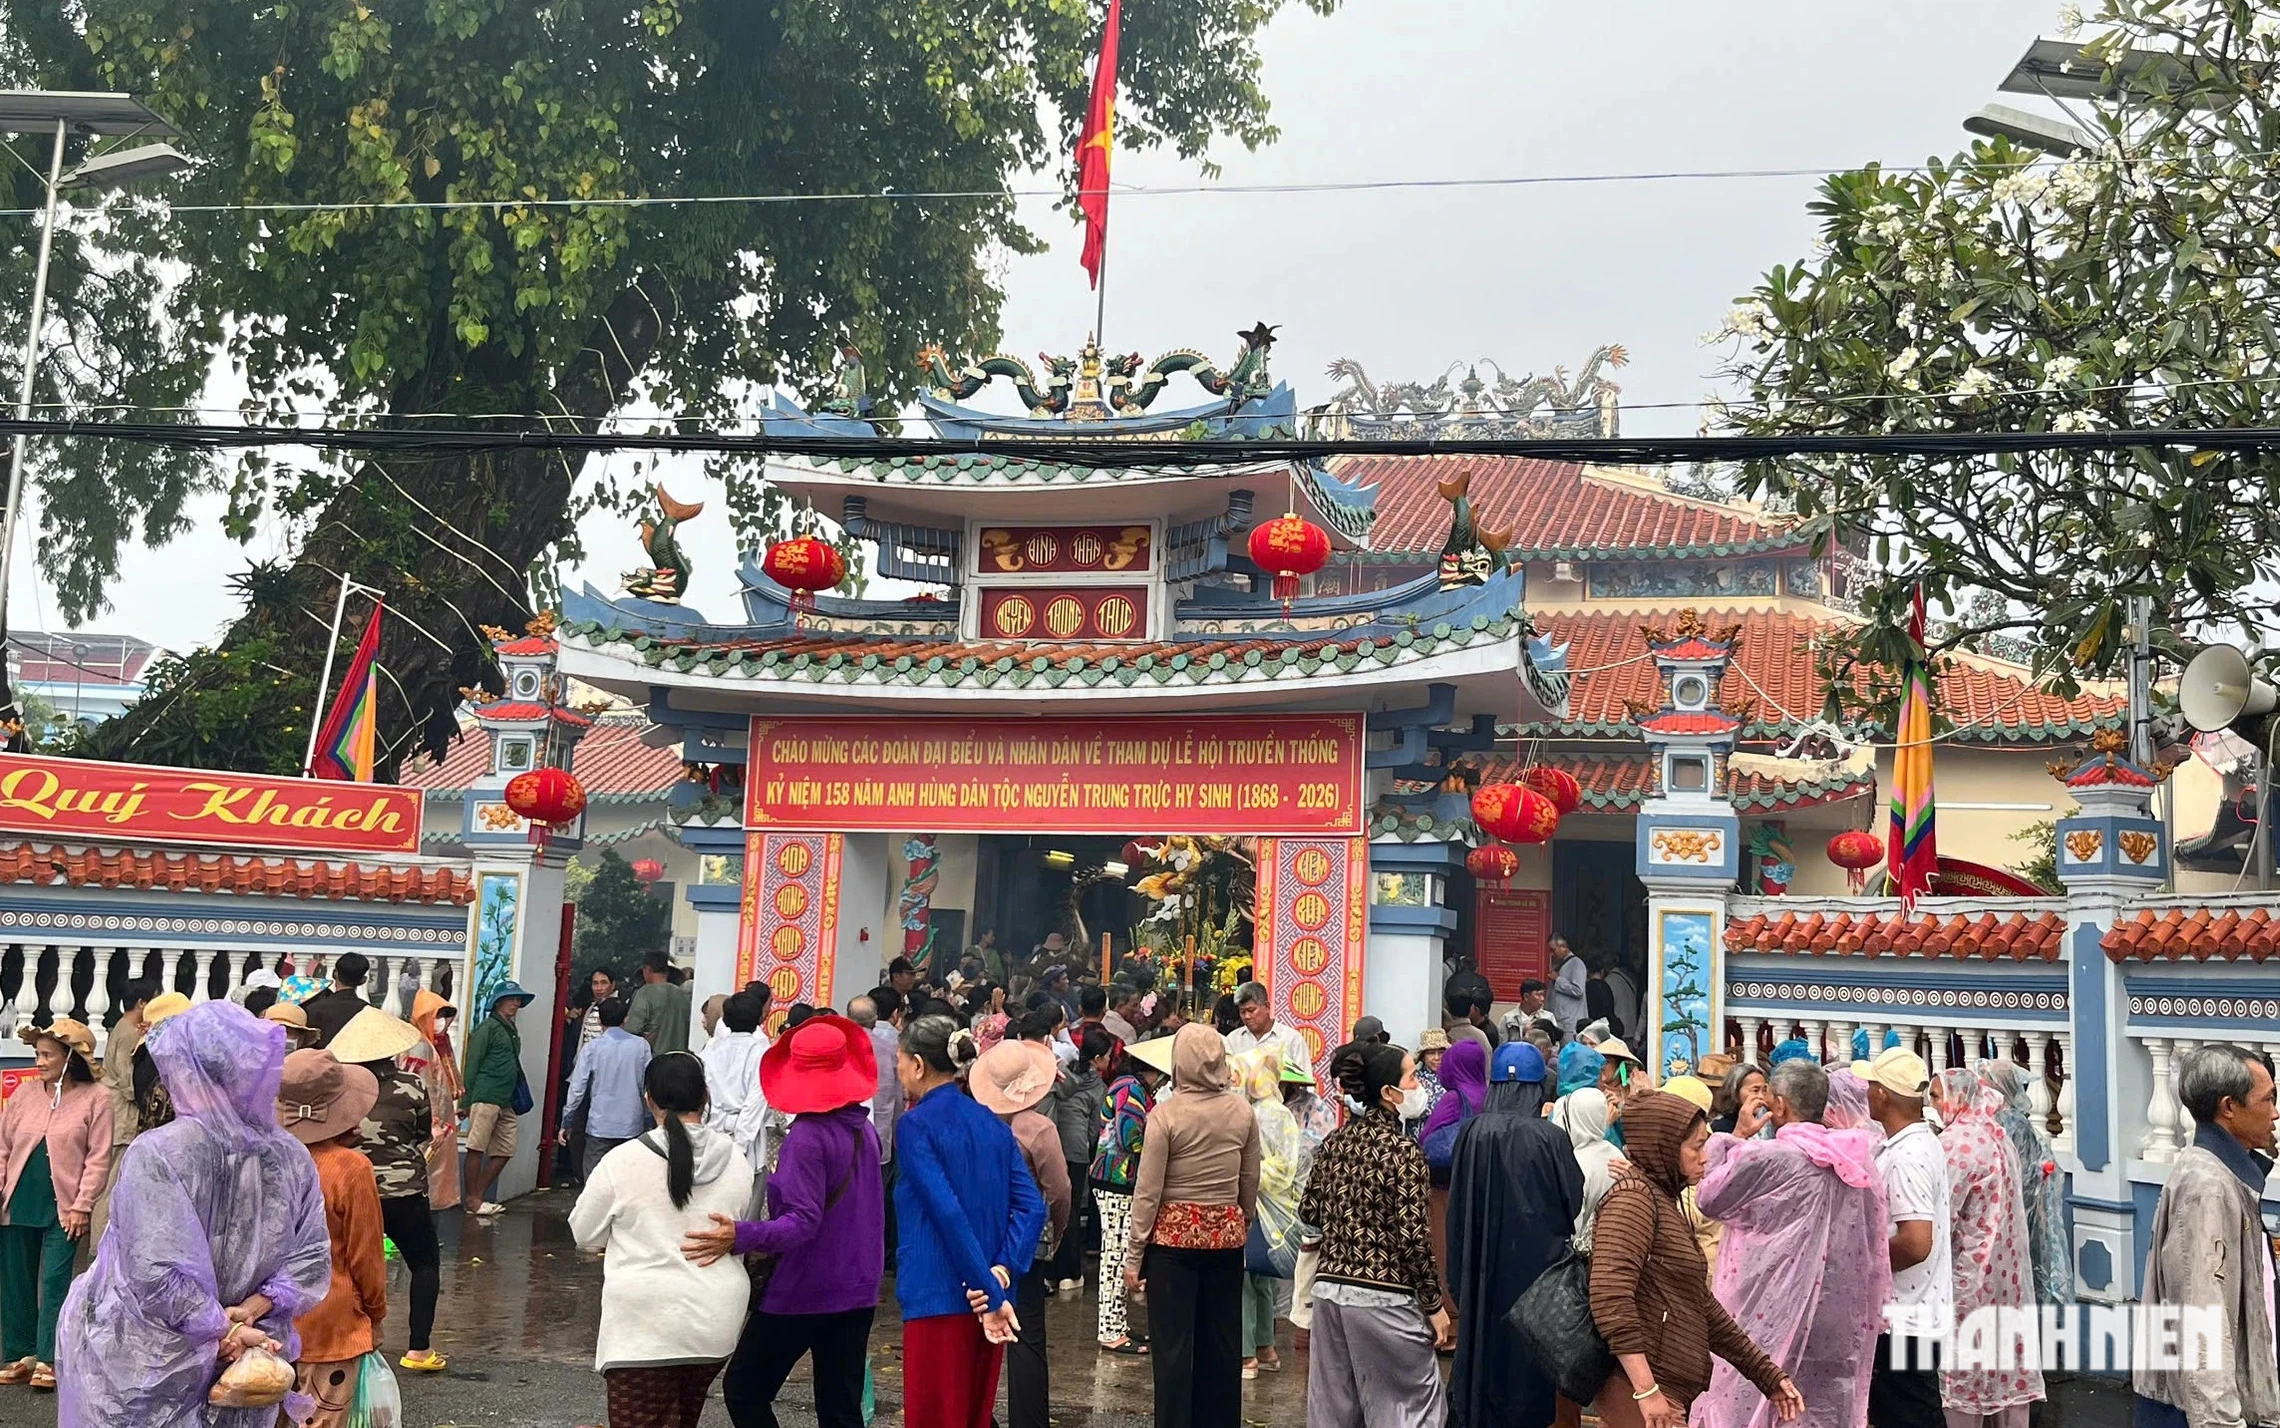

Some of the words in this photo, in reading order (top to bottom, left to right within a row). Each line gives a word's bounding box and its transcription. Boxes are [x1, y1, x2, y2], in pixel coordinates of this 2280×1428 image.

[1047, 598, 1082, 635] TRUNG
[773, 734, 808, 764] CHÀO
[812, 736, 848, 764] MỪNG
[852, 735, 878, 764] CÁC
[882, 735, 919, 764] ĐOÀN
[924, 740, 946, 769] ĐẠI
[951, 729, 982, 764] BIỂU
[988, 736, 1004, 764] VÀ
[1010, 736, 1046, 765] NHÂN
[1052, 735, 1080, 765] DÂN
[1085, 731, 1103, 764] VỀ
[1108, 740, 1146, 764] THAM
[1151, 737, 1172, 769] DỰ
[1176, 730, 1193, 764] LỄ
[1198, 734, 1223, 769] HỘI
[1228, 730, 1284, 764] TRUYỀN
[1289, 730, 1338, 764] THỐNG
[0, 768, 150, 823] Quý
[168, 782, 405, 834] Khách
[766, 772, 784, 804] KỶ
[788, 776, 821, 810] NIỆM
[825, 782, 850, 805] 158
[854, 778, 884, 806] NĂM
[887, 783, 914, 806] ANH
[919, 777, 956, 807] HÙNG
[960, 777, 988, 807] DÂN
[993, 778, 1020, 812] TỘC
[1024, 773, 1079, 807] NGUYỄN
[1084, 784, 1129, 808] TRUNG
[1134, 780, 1171, 813] TRỰC
[1176, 784, 1194, 808] HY
[1199, 784, 1232, 808] SINH
[1237, 784, 1278, 810] (1868
[1297, 784, 1339, 810] 2026)
